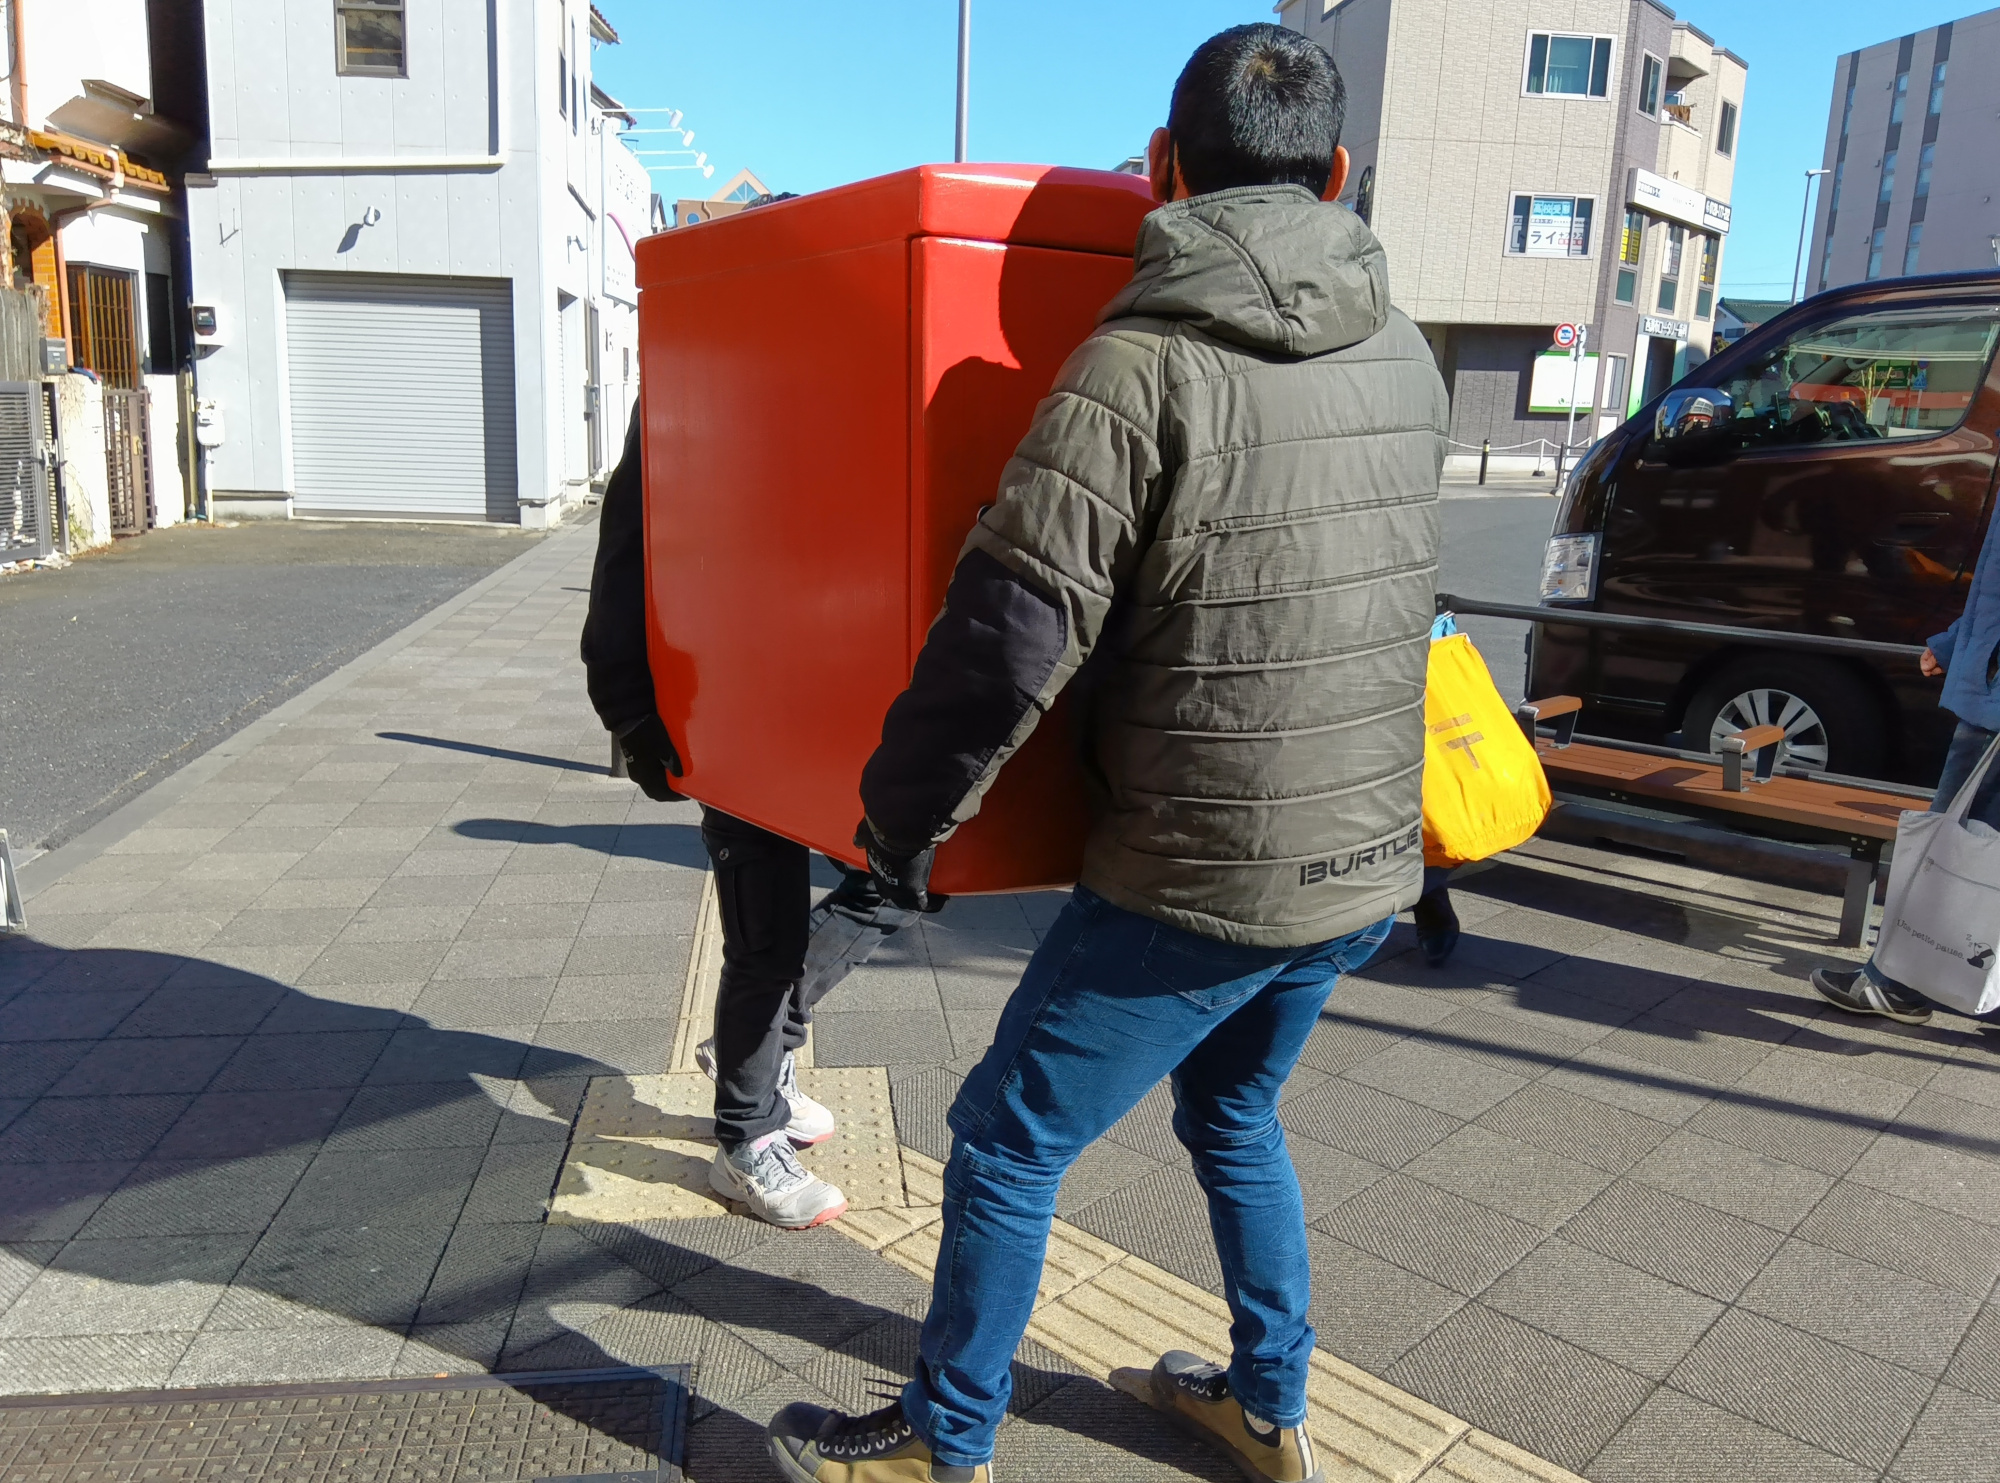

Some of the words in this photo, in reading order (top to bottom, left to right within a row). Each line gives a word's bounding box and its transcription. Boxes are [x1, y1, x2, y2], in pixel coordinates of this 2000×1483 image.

[1300, 824, 1419, 886] BURTLE
[1912, 929, 1935, 946] petite
[1935, 943, 1965, 960] pause.
